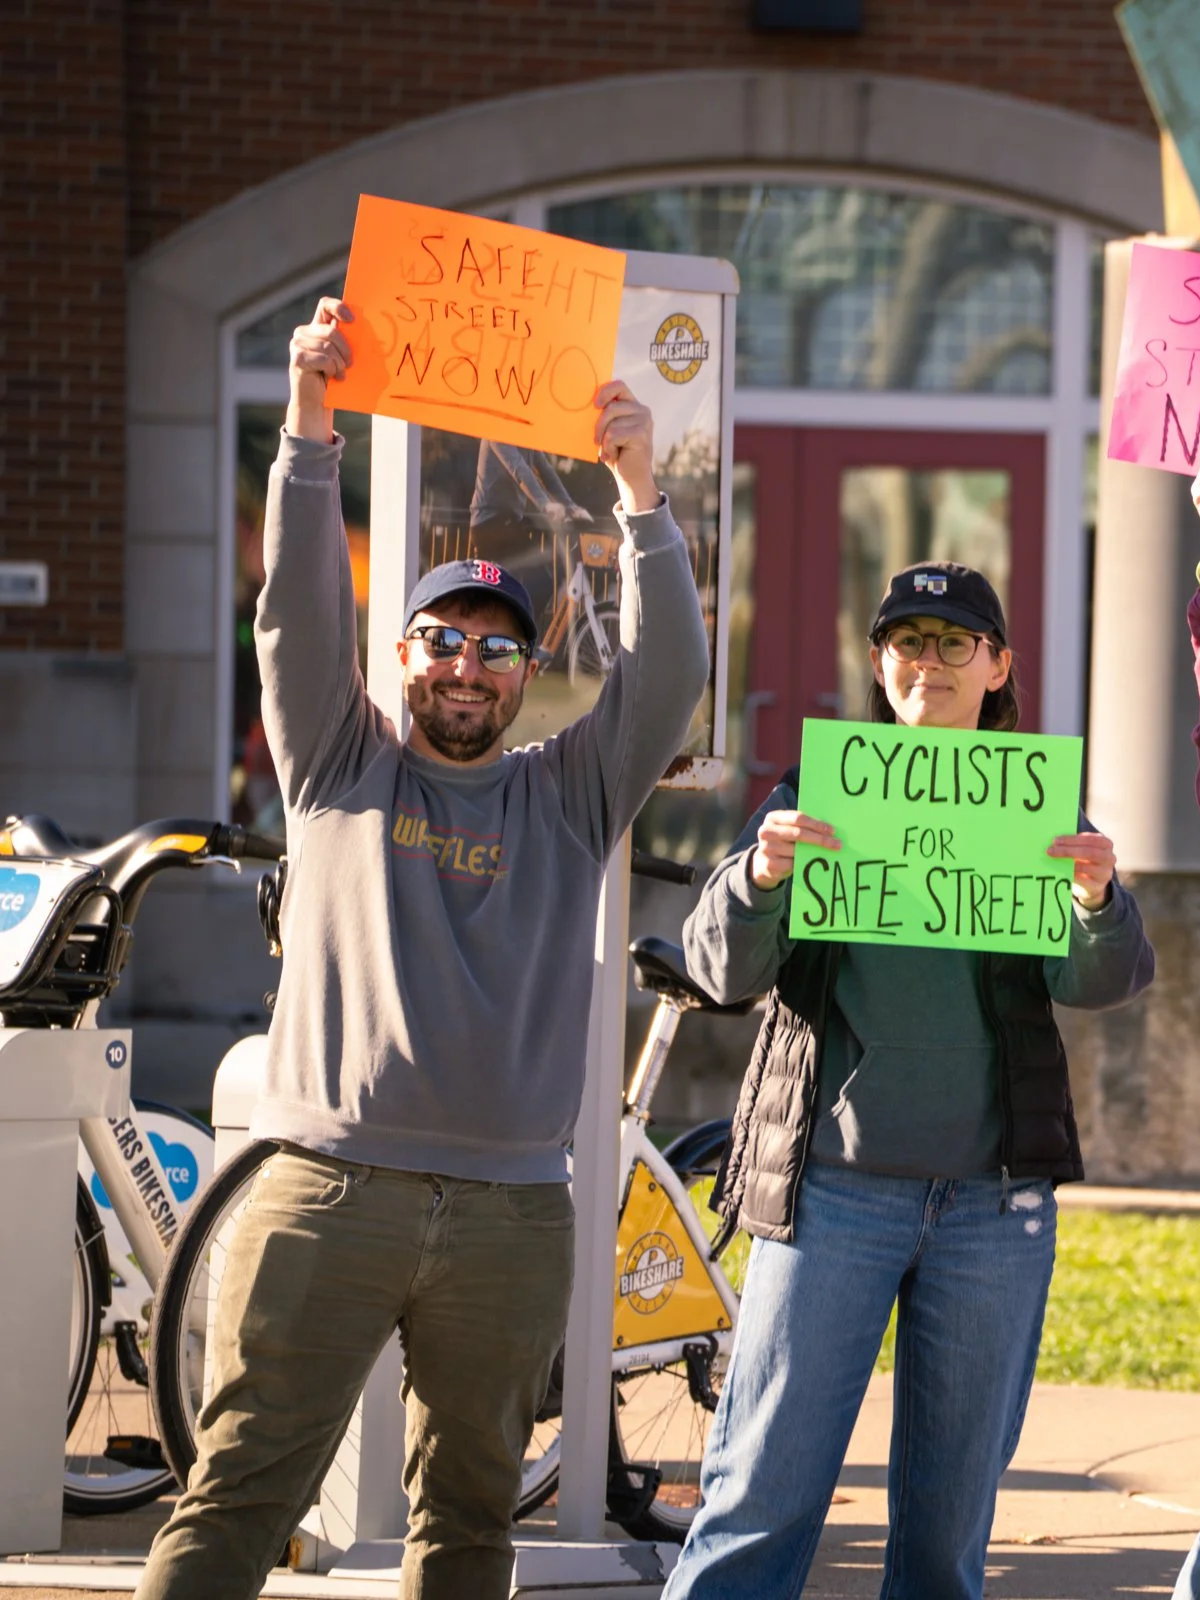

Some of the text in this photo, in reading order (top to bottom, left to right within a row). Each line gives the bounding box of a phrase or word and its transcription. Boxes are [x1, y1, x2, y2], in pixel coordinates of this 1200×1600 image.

[407, 235, 543, 288] SAFE
[395, 295, 533, 338] STREETS
[650, 343, 708, 361] BIKESHARE
[396, 343, 536, 406] NOW
[841, 735, 1048, 812] CYCLISTS
[903, 825, 956, 861] FOR
[802, 857, 1072, 943] SAFE STREETS
[108, 1046, 124, 1063] 10
[620, 1256, 684, 1296] BIKESHARE
